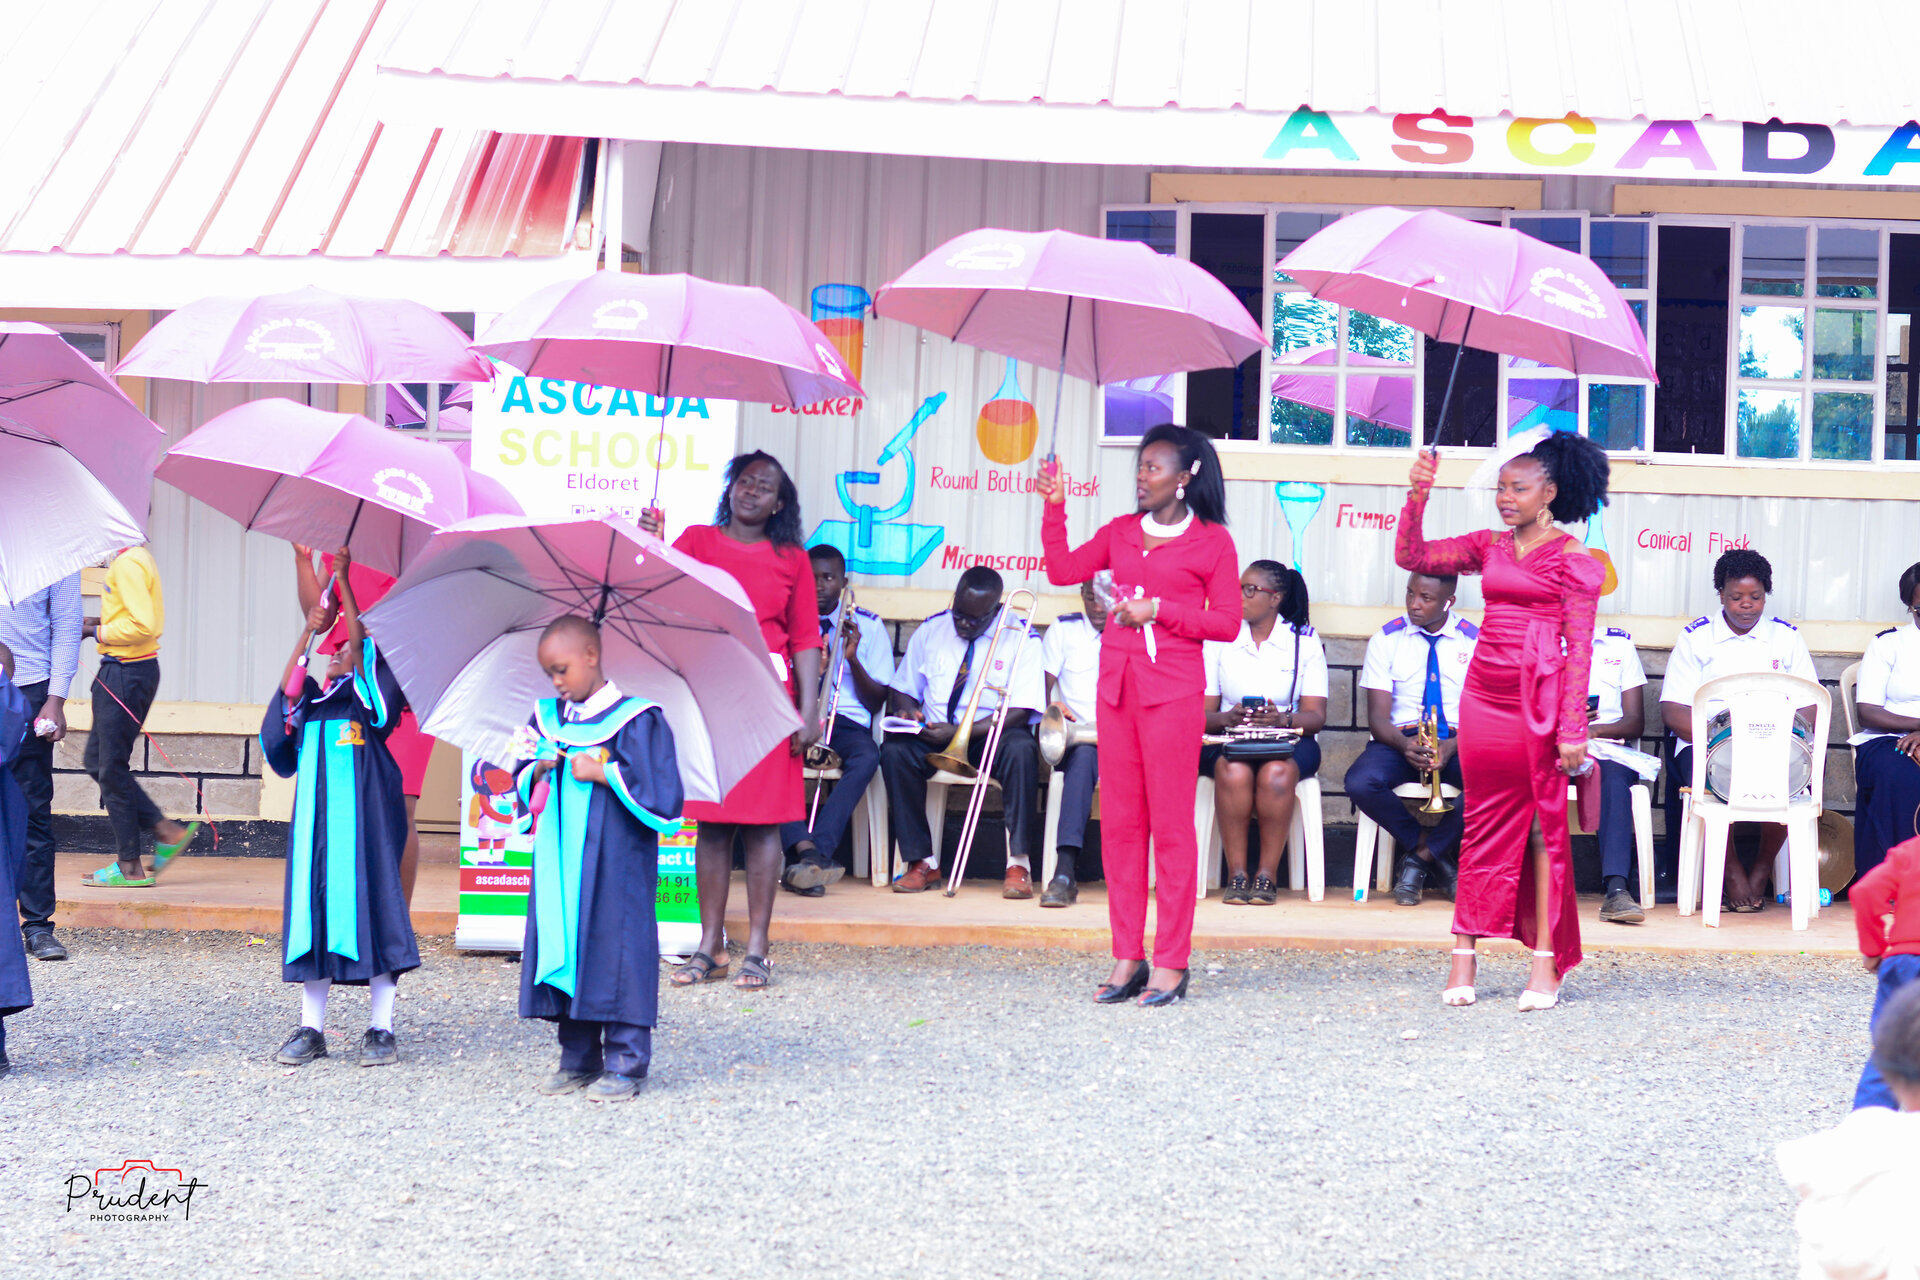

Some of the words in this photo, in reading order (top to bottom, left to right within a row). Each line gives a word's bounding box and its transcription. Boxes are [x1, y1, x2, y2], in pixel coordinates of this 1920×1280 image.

[500, 375, 710, 419] ASCADA
[498, 427, 710, 471] SCHOOL
[567, 473, 640, 491] Eldoret
[931, 466, 979, 491] Round
[1637, 528, 1692, 553] Conical
[1708, 531, 1751, 554] Flask
[675, 876, 689, 888] 91
[675, 892, 690, 904] 67
